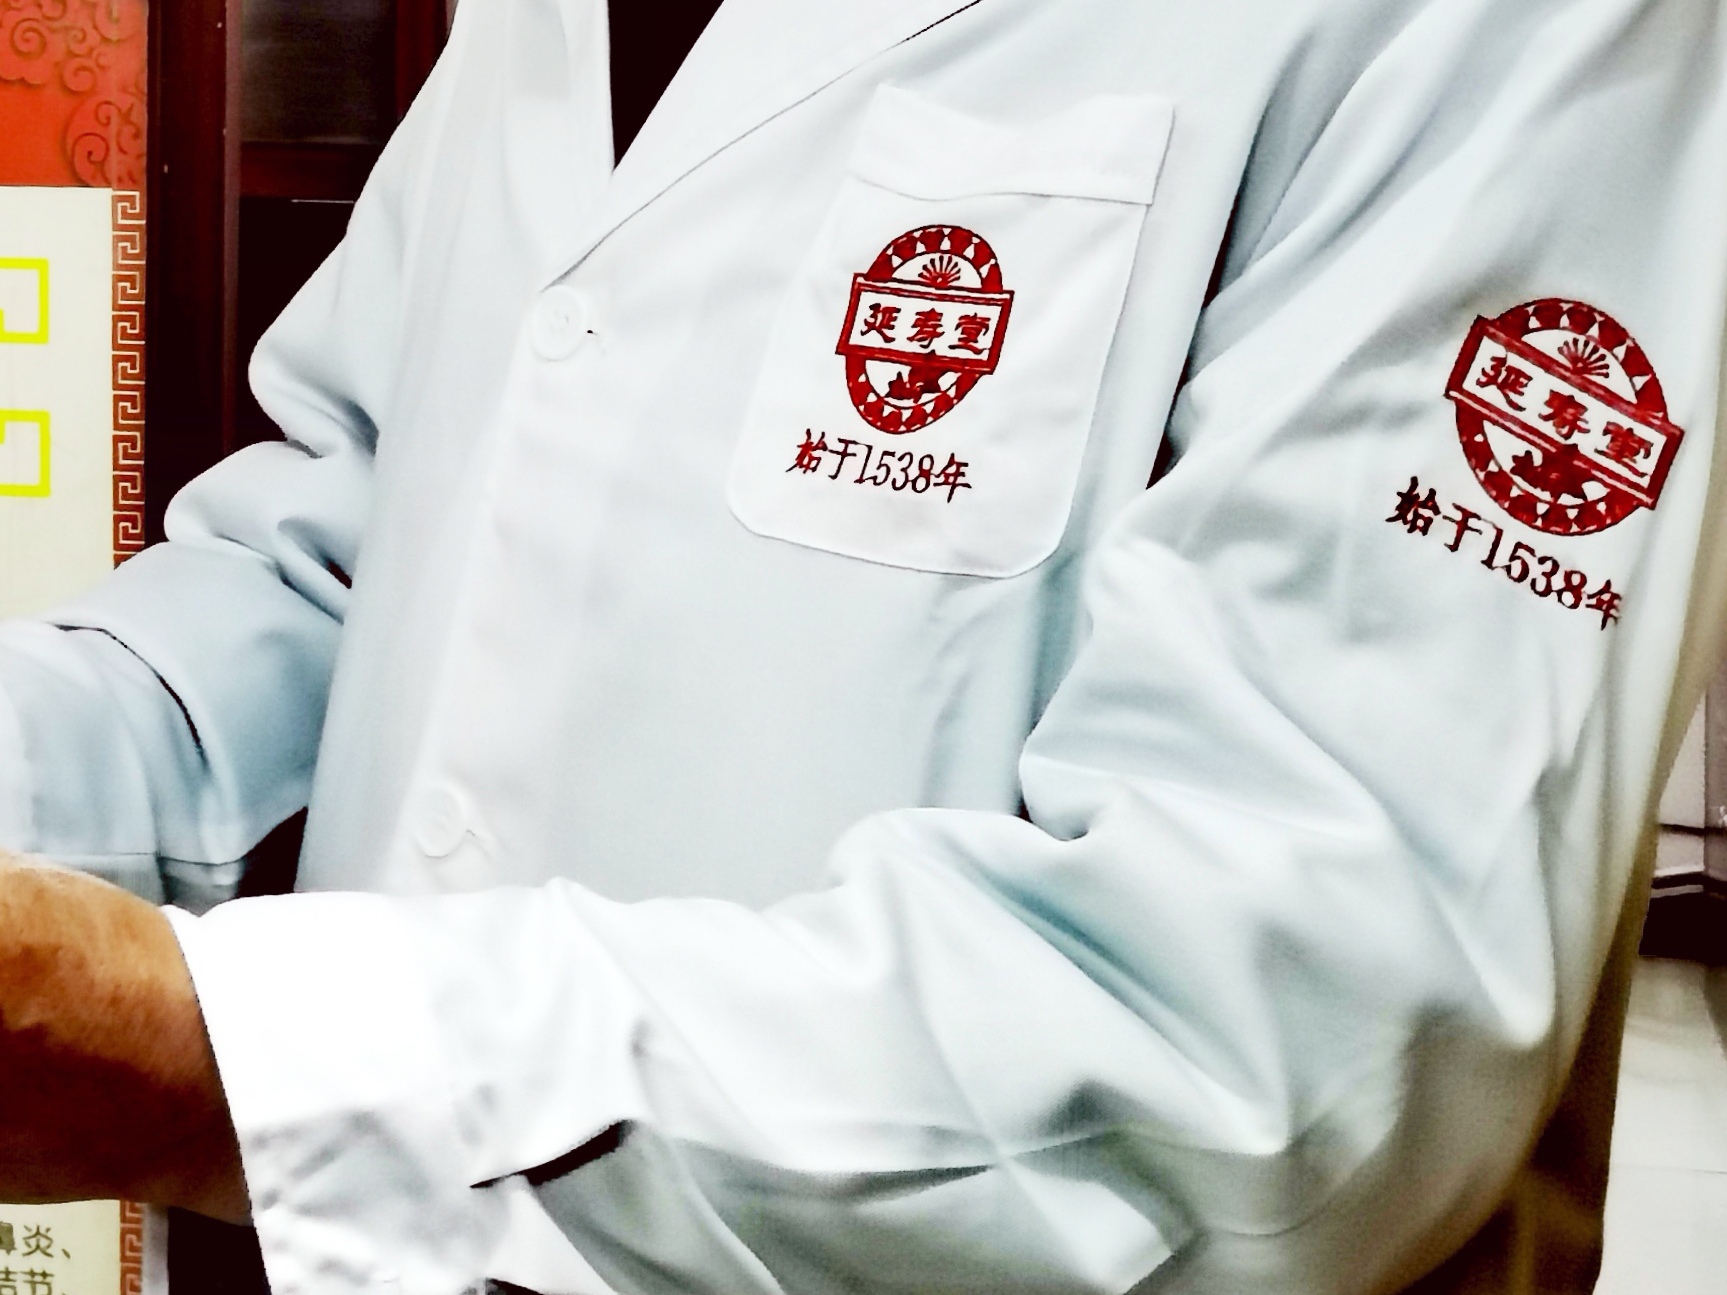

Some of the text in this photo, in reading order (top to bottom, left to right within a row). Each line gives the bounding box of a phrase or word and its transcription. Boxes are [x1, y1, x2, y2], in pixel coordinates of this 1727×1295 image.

[860, 303, 992, 355] 延寿堂
[785, 428, 972, 503] 始于1538年
[1385, 475, 1622, 631] 始于1538年
